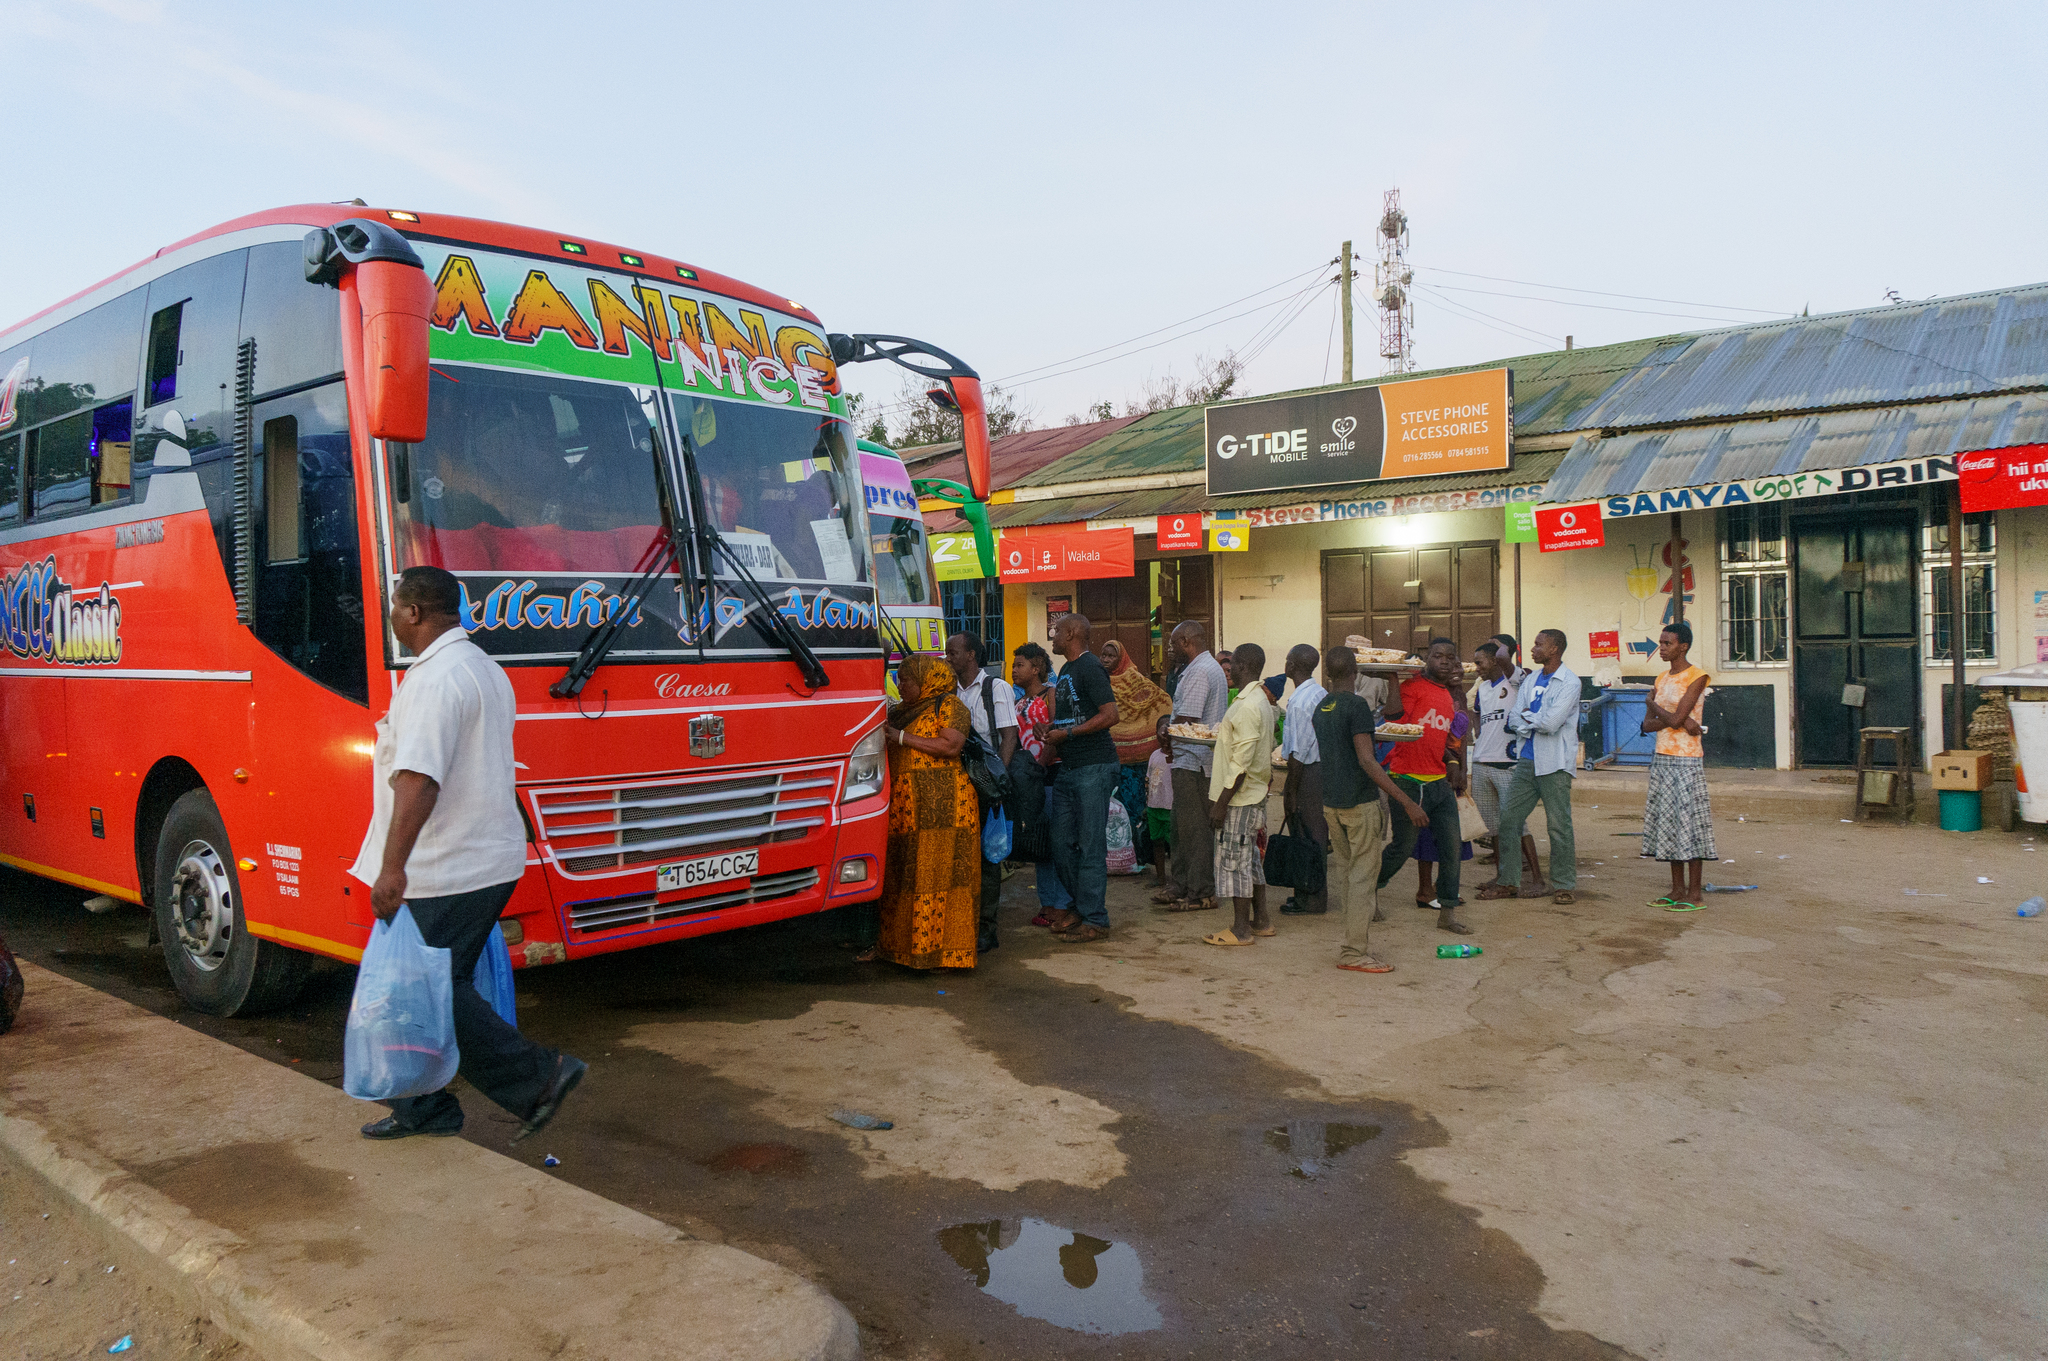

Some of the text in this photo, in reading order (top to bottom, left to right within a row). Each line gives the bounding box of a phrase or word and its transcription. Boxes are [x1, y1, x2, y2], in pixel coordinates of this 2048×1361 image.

[674, 338, 830, 411] NICE
[1401, 403, 1489, 425] STEVE PHONE
[1401, 420, 1489, 442] ACCESSORIES
[1320, 439, 1356, 453] smile
[1270, 452, 1308, 464] MOBILE
[1403, 446, 1489, 463] 0716 285566 0784 581515
[1961, 457, 1996, 472] Coca-Cola
[2008, 461, 2028, 476] hii
[1607, 484, 1750, 518] SAMYA
[1753, 474, 1833, 501] SOFT
[1246, 507, 1315, 527] Steve
[1320, 499, 1387, 521] Phone
[1513, 512, 1532, 520] Ongez
[1553, 528, 1587, 537] vodacom
[1160, 541, 1186, 549] inapatikana
[1544, 538, 1599, 550] inapatikana hapa
[1067, 550, 1100, 562] Wakala
[1003, 567, 1029, 575] vodacom
[1660, 539, 1696, 630] CAF
[53, 585, 121, 662] Classic
[655, 673, 732, 699] Caesa
